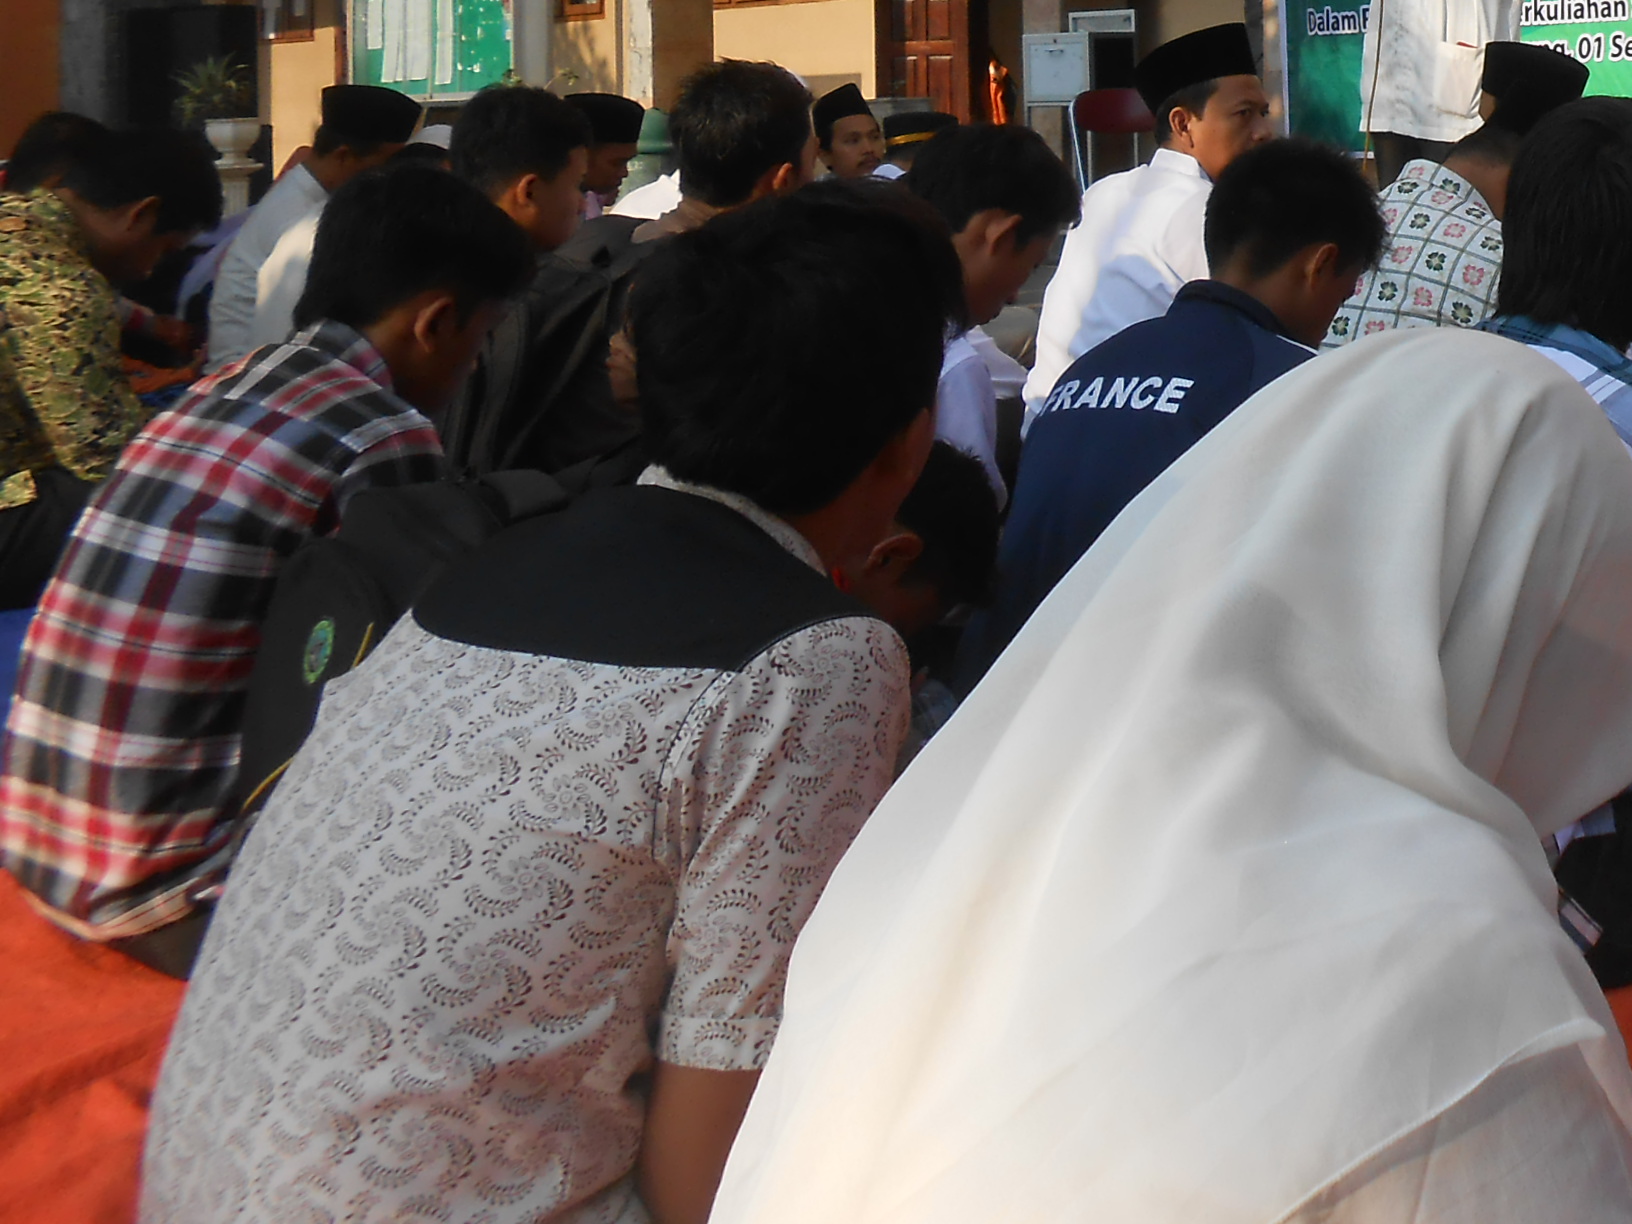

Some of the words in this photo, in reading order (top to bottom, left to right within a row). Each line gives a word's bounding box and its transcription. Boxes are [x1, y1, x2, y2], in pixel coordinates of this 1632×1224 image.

[1308, 8, 1358, 33] Dalam
[1578, 35, 1604, 61] 01
[1040, 376, 1194, 417] FRANCE
